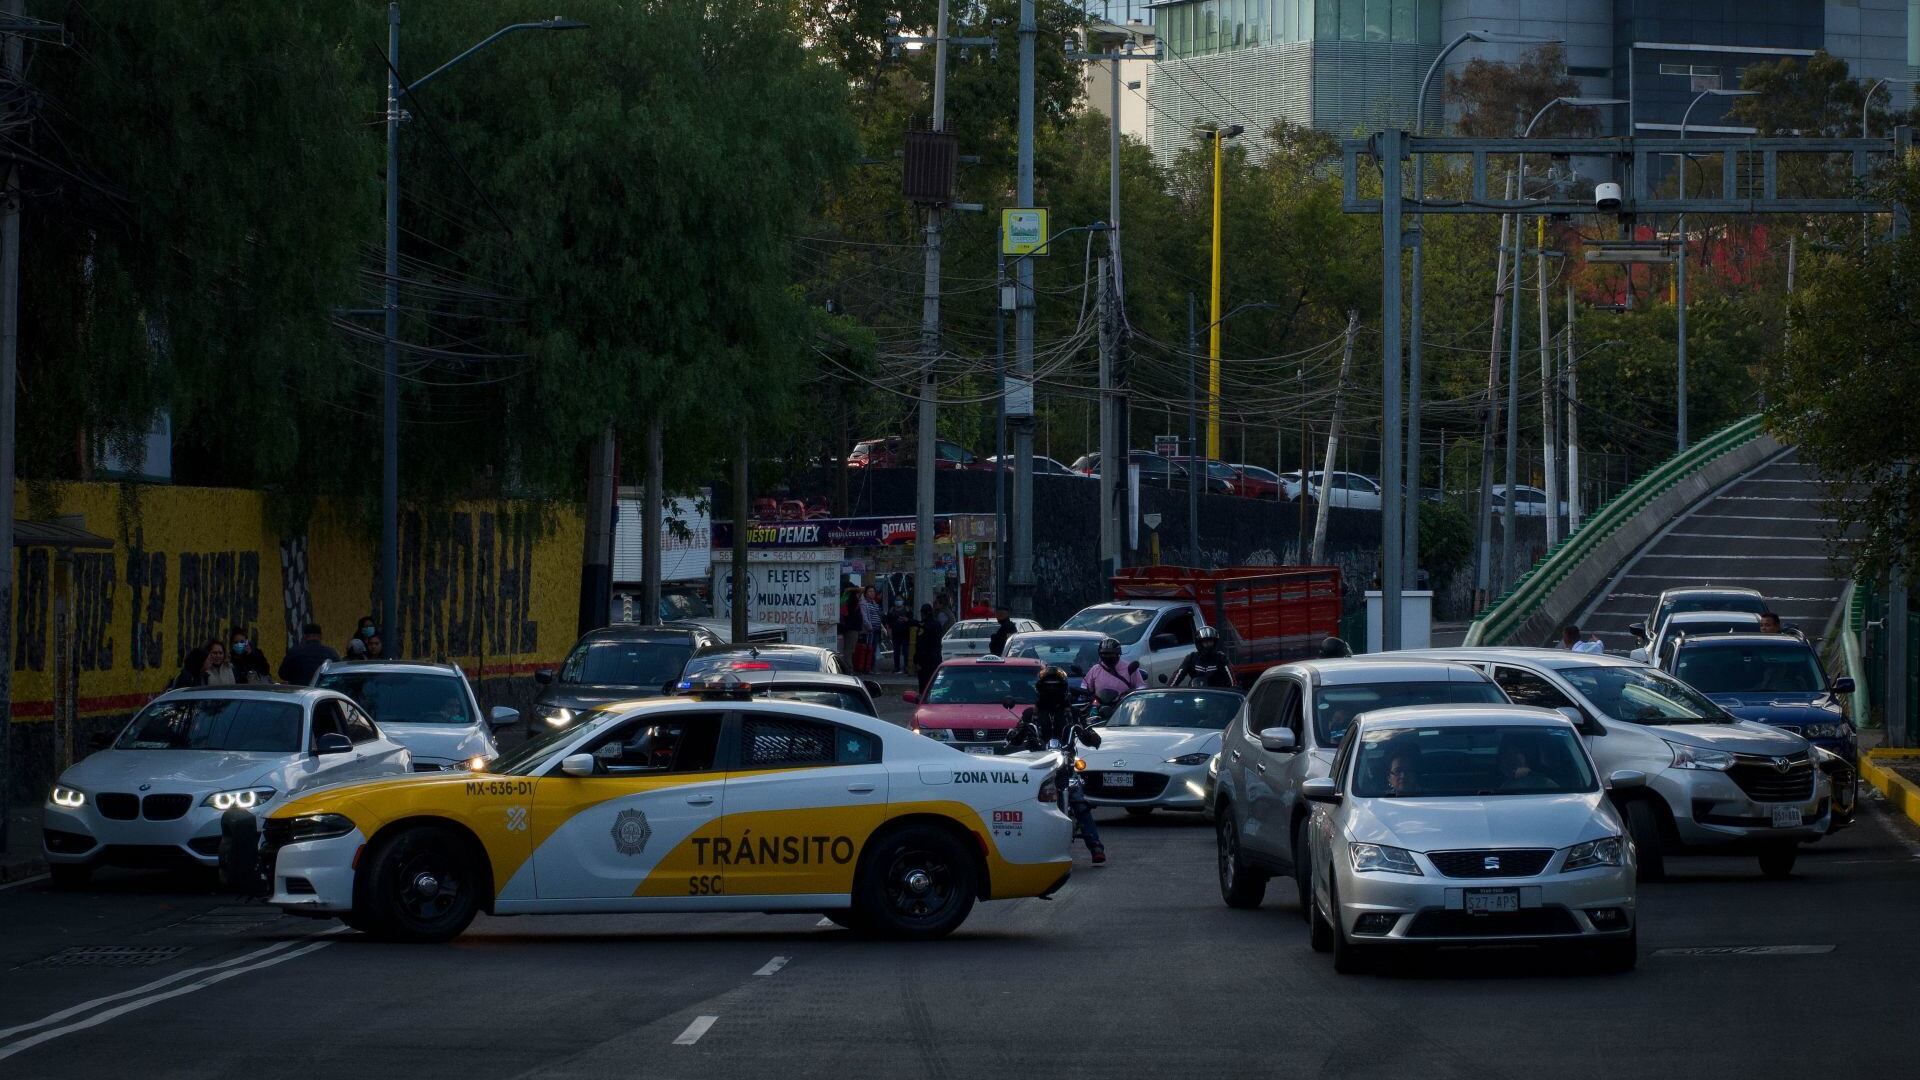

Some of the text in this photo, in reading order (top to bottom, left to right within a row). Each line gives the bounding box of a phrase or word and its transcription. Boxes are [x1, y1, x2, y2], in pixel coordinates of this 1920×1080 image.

[747, 526, 820, 543] UESTO PEMEX
[828, 530, 877, 538] ORGULLOSAMENTE
[881, 522, 917, 539] BOTANE
[768, 570, 810, 582] FLETES
[782, 583, 788, 591] Y
[758, 593, 816, 606] MUDANZAS
[759, 610, 816, 624] PEDREGAL
[953, 771, 1029, 785] ZONA VIAL 4
[466, 781, 532, 796] MX-636-D1
[994, 811, 1021, 821] 911
[691, 828, 855, 865] TRÁNSITO
[689, 875, 722, 895] SSC
